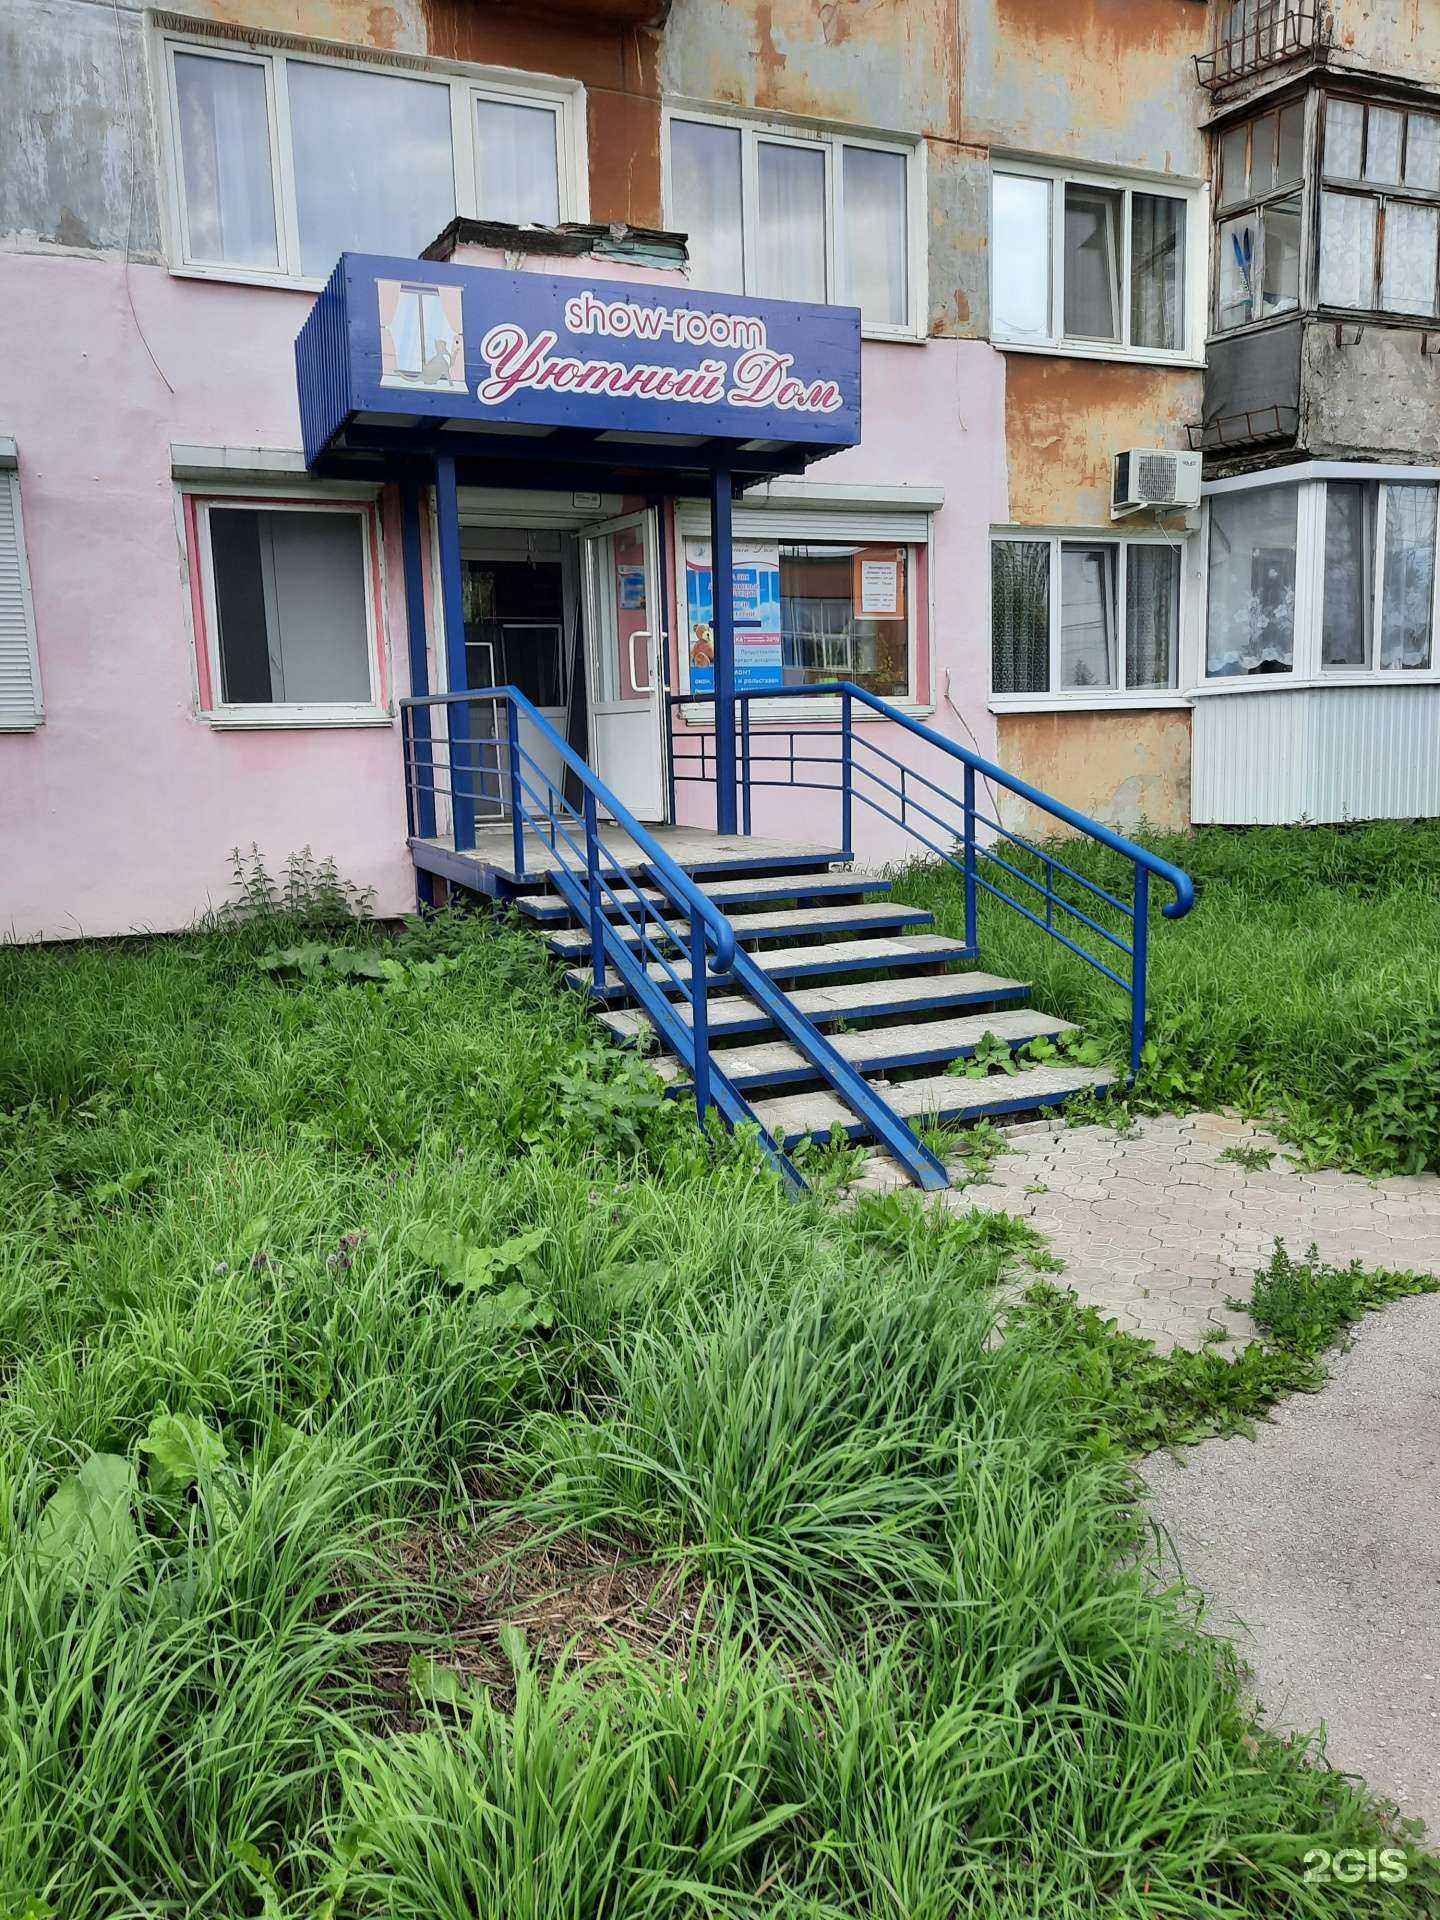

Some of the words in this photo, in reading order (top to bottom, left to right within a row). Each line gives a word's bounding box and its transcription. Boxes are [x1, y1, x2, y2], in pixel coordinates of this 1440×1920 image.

[567, 294, 764, 348] show-room
[481, 327, 725, 402] Уютный
[731, 352, 842, 410] Дом
